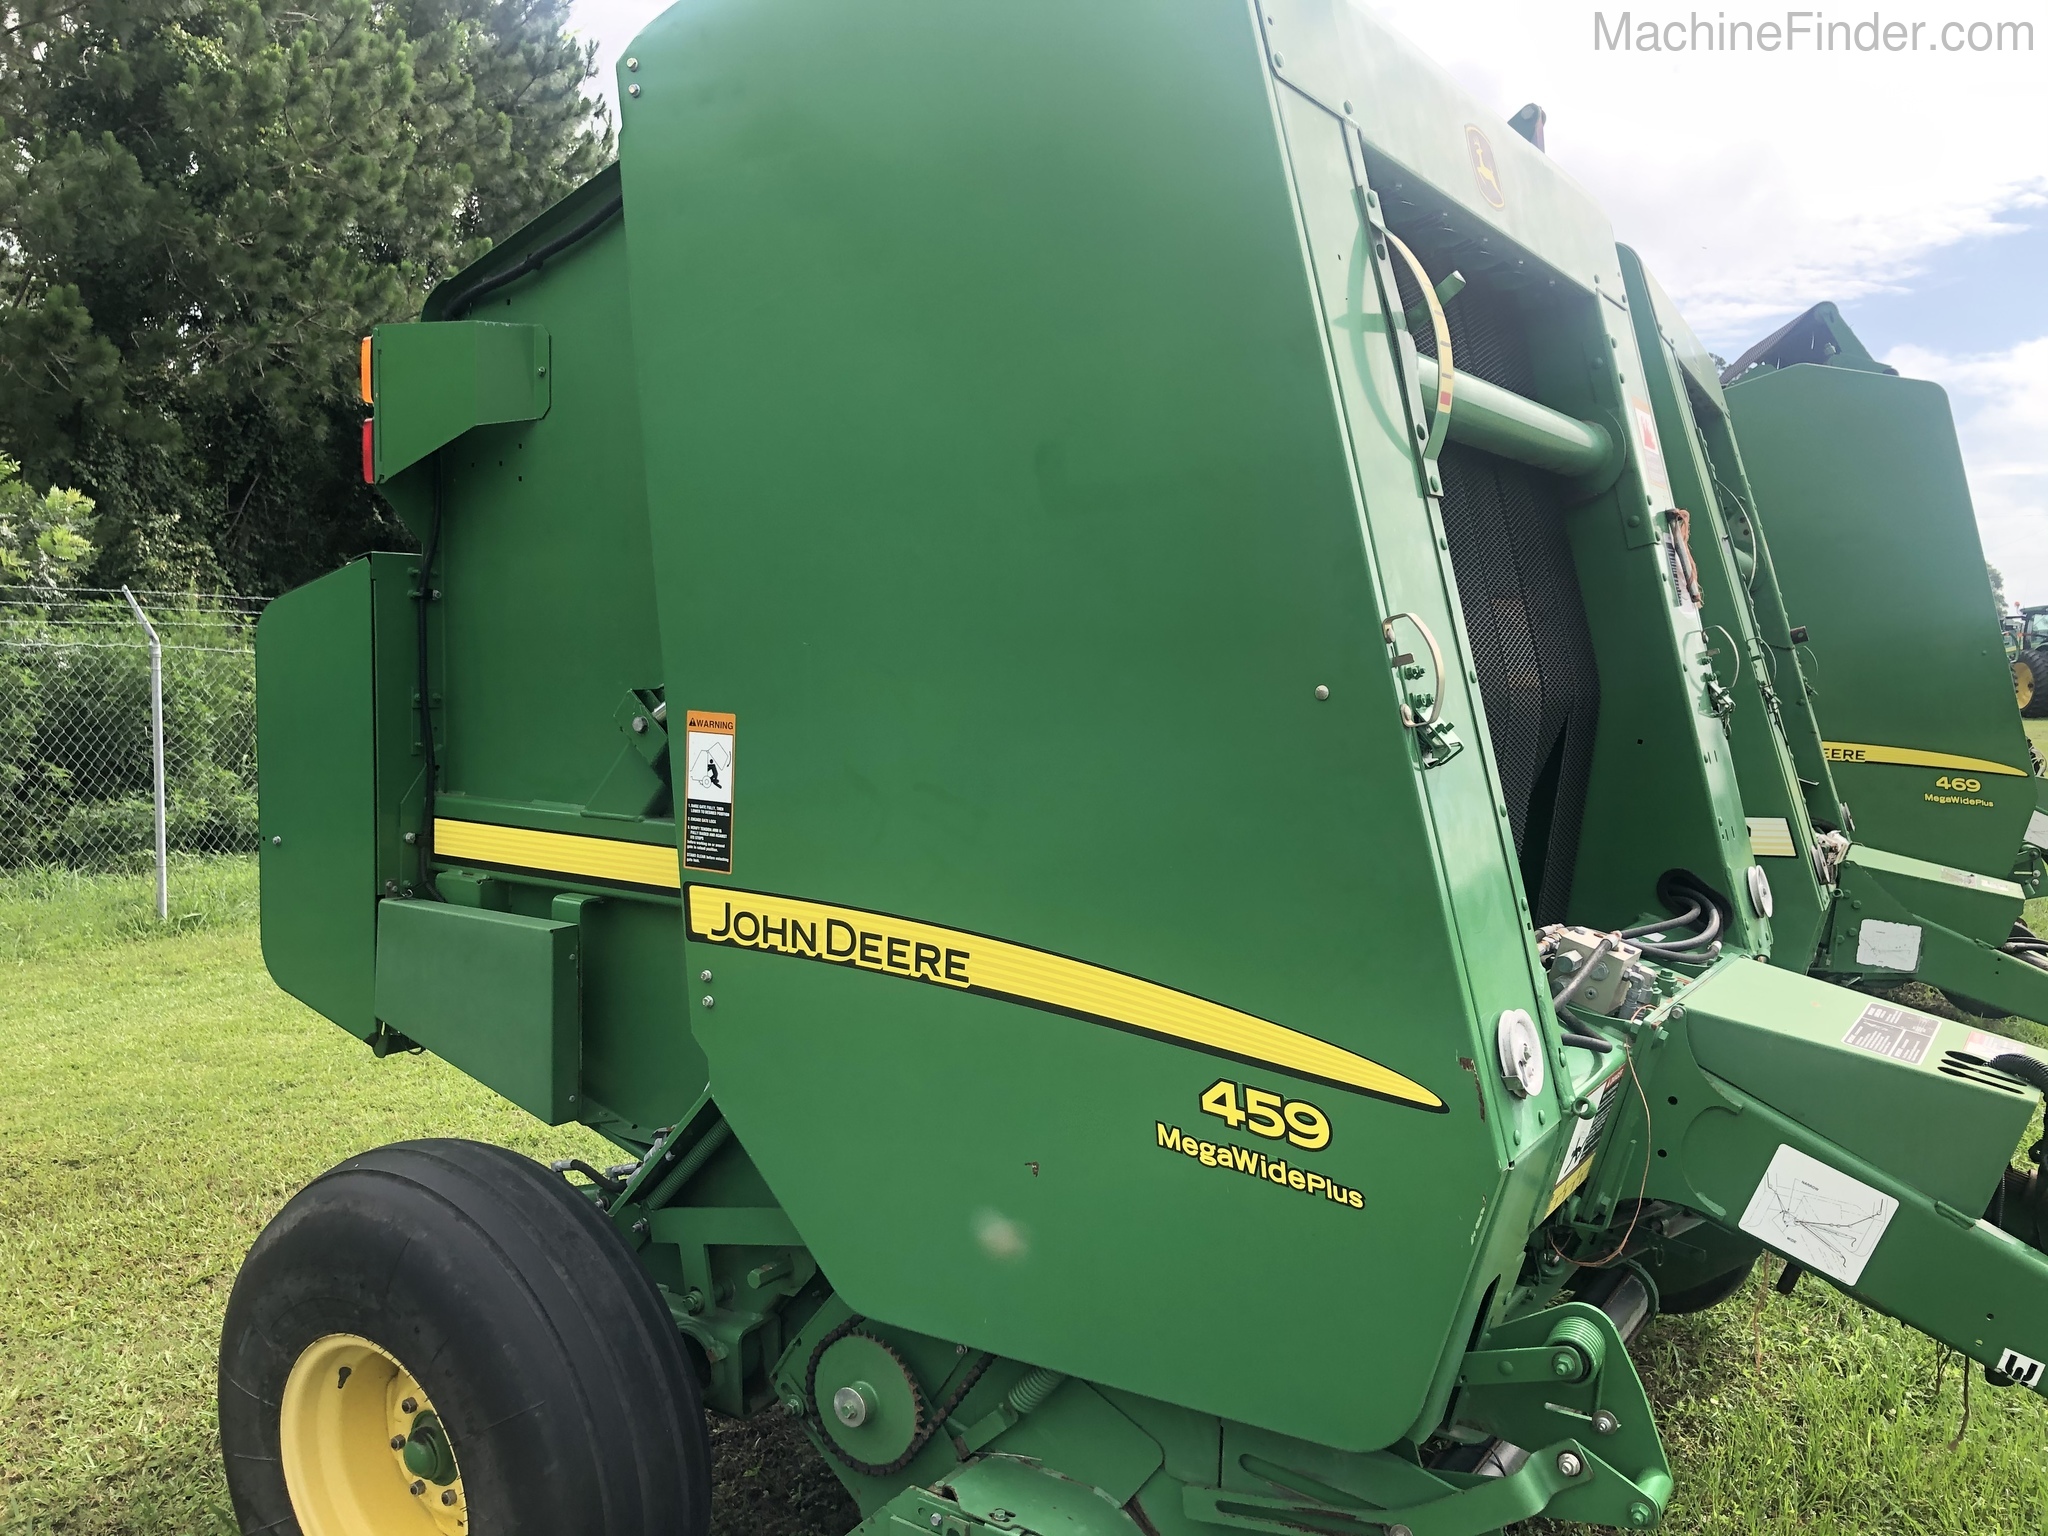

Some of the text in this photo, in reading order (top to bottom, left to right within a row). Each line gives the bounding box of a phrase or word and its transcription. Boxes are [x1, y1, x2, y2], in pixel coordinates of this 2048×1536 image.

[696, 720, 733, 730] WARNING
[1823, 748, 1866, 760] EERE
[1935, 776, 1981, 792] 469
[1924, 793, 1994, 807] MegaWidePlus
[710, 902, 971, 984] JOHN DEERE
[1200, 1079, 1332, 1150] 459
[1156, 1121, 1366, 1209] MegaWidePlus
